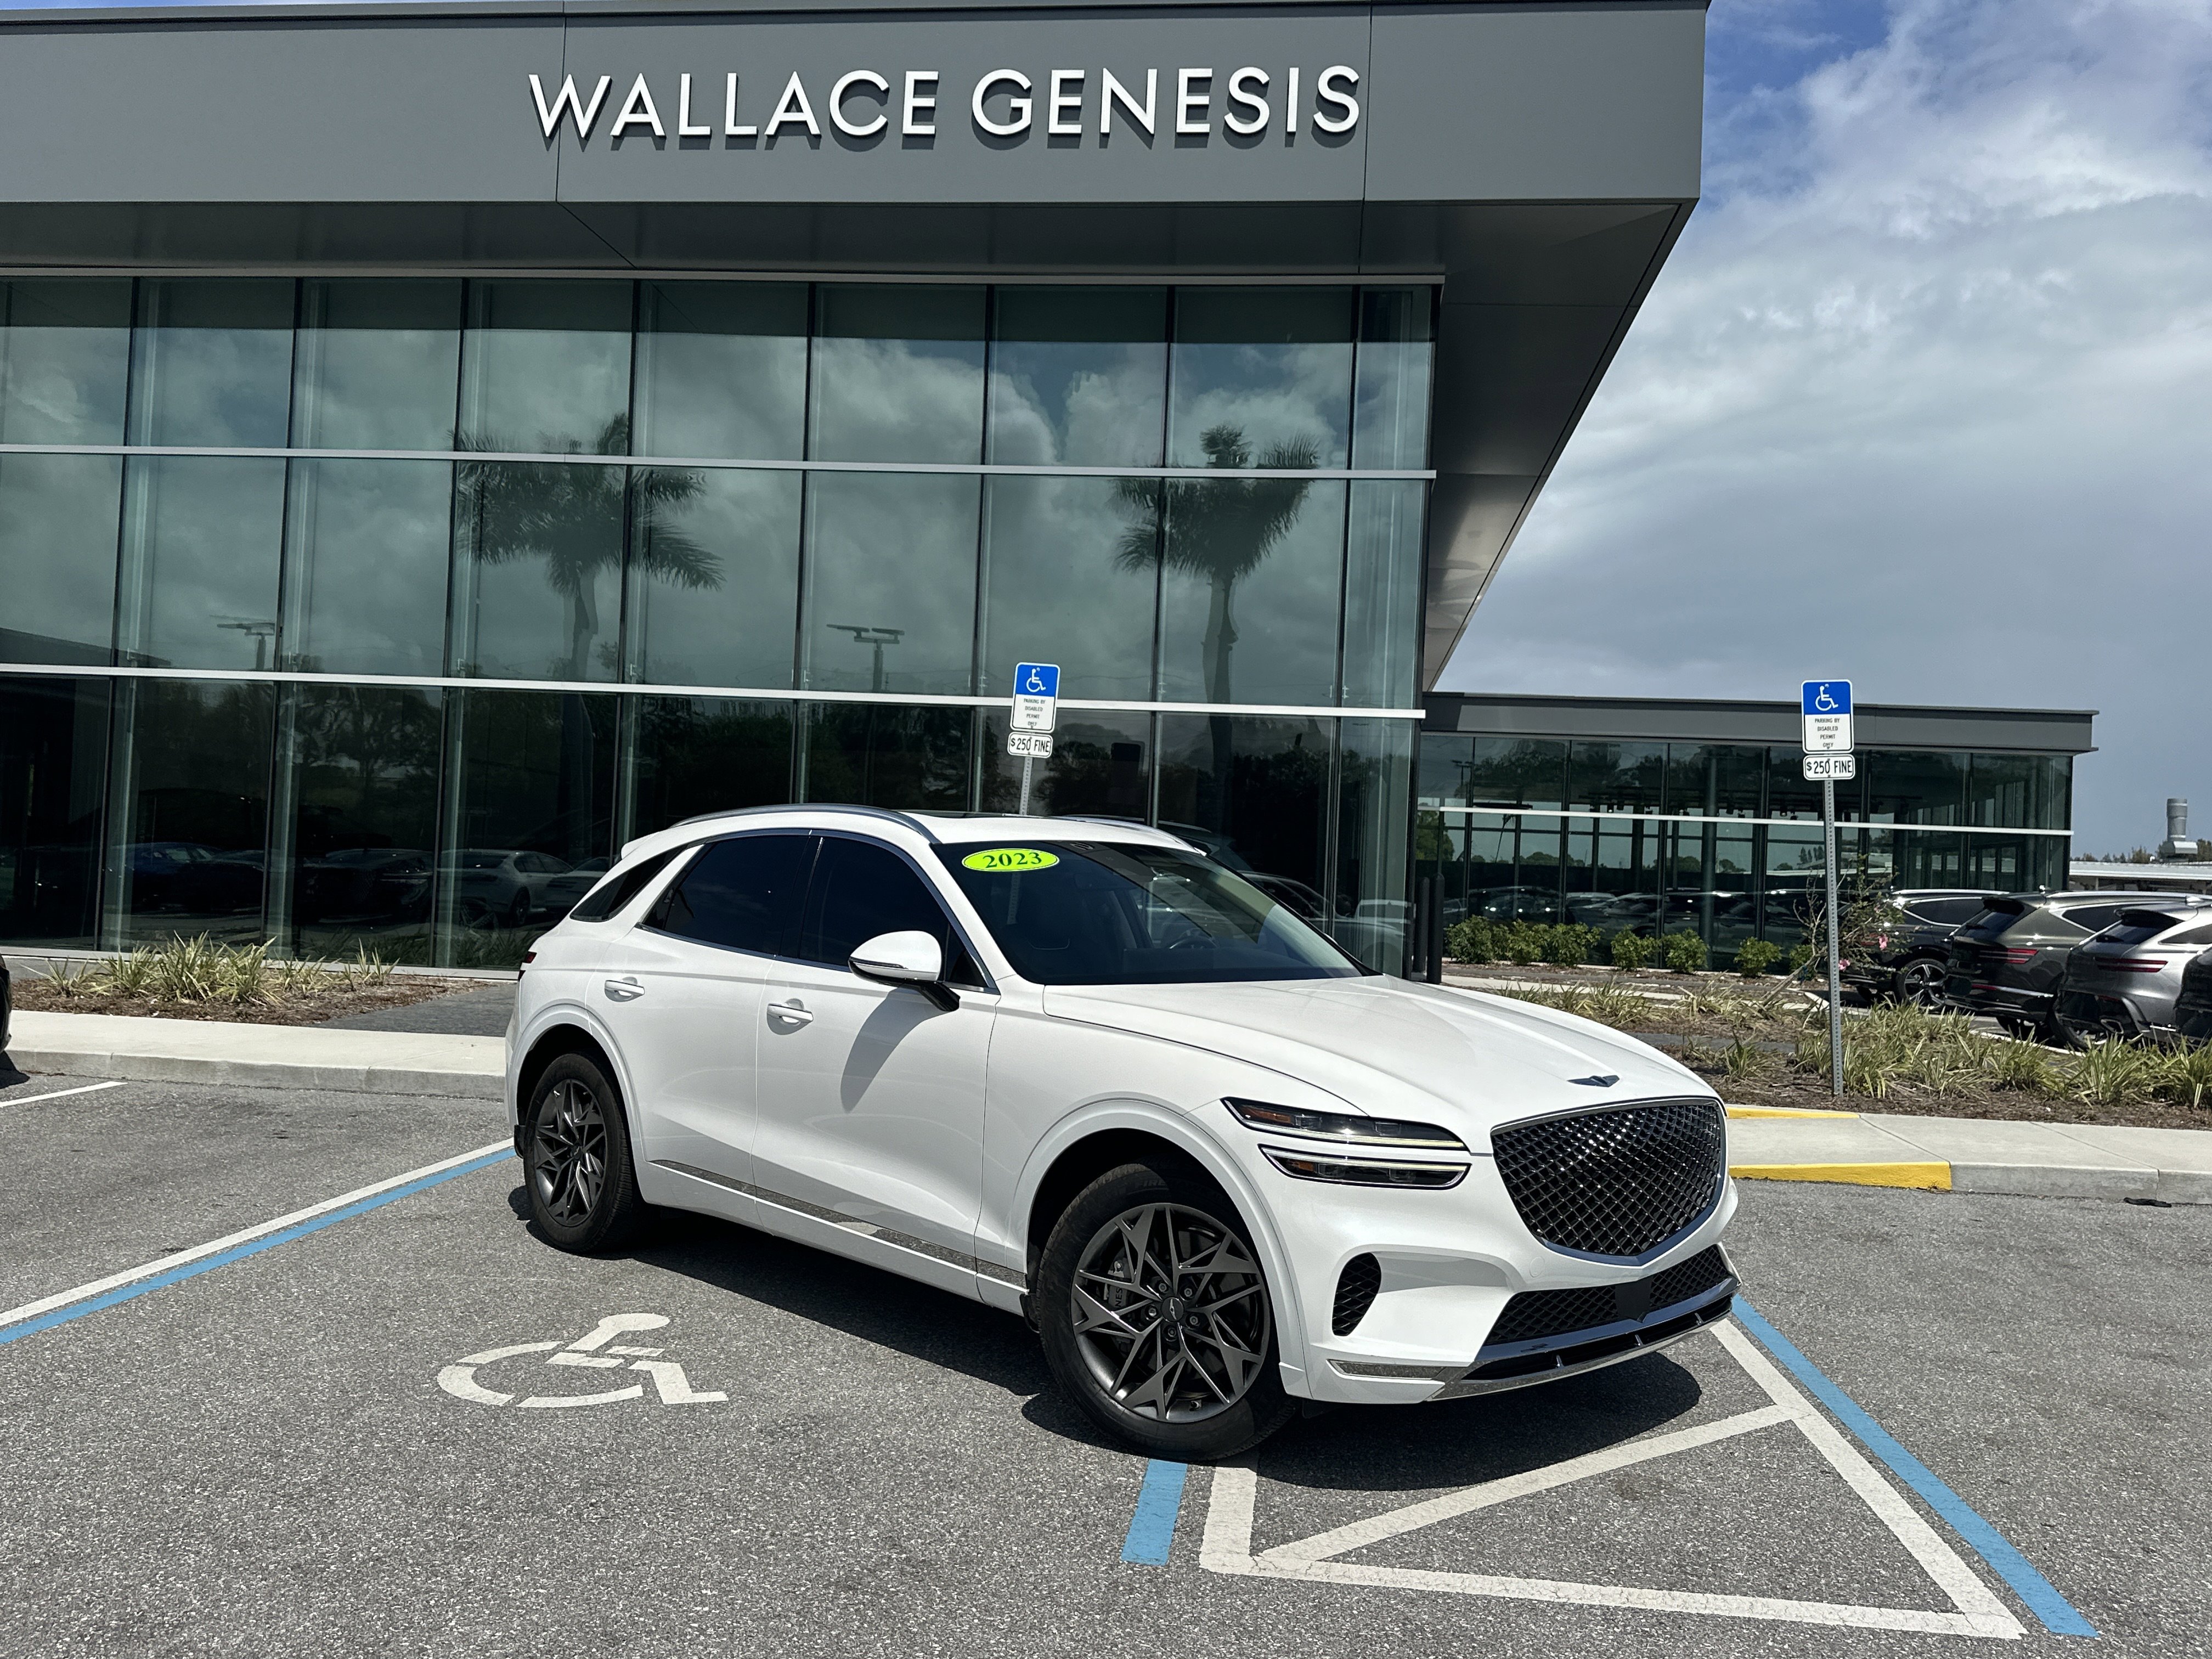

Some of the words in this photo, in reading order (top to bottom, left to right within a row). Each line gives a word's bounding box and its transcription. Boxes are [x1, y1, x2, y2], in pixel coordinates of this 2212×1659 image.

[528, 69, 939, 138] WALLACE
[972, 65, 1360, 136] GENESIS
[1034, 740, 1051, 753] FINE
[1834, 760, 1853, 774] FINE
[983, 852, 1042, 868] 2023
